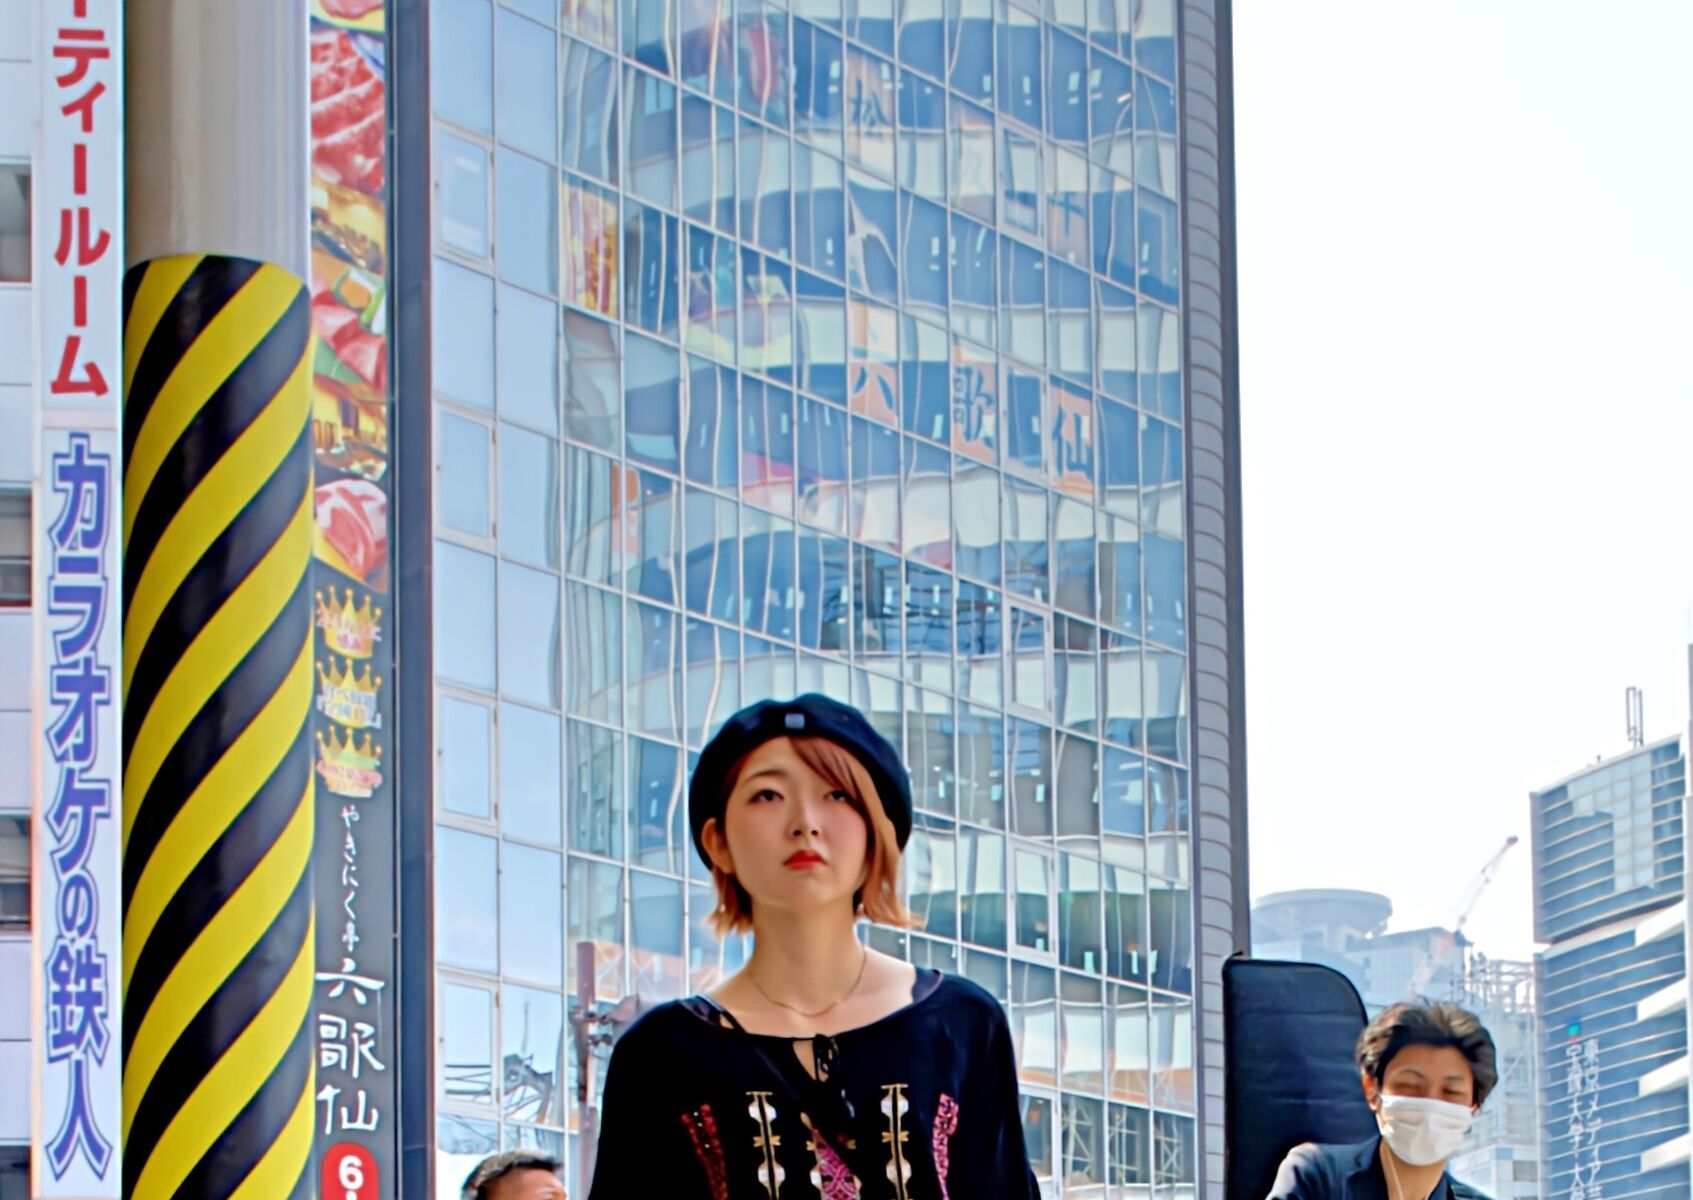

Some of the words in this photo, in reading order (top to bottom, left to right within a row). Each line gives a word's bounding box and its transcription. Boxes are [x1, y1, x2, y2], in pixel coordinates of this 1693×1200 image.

[45, 432, 113, 1181] カラオケの鉄人
[315, 957, 386, 1136] 六歌仙
